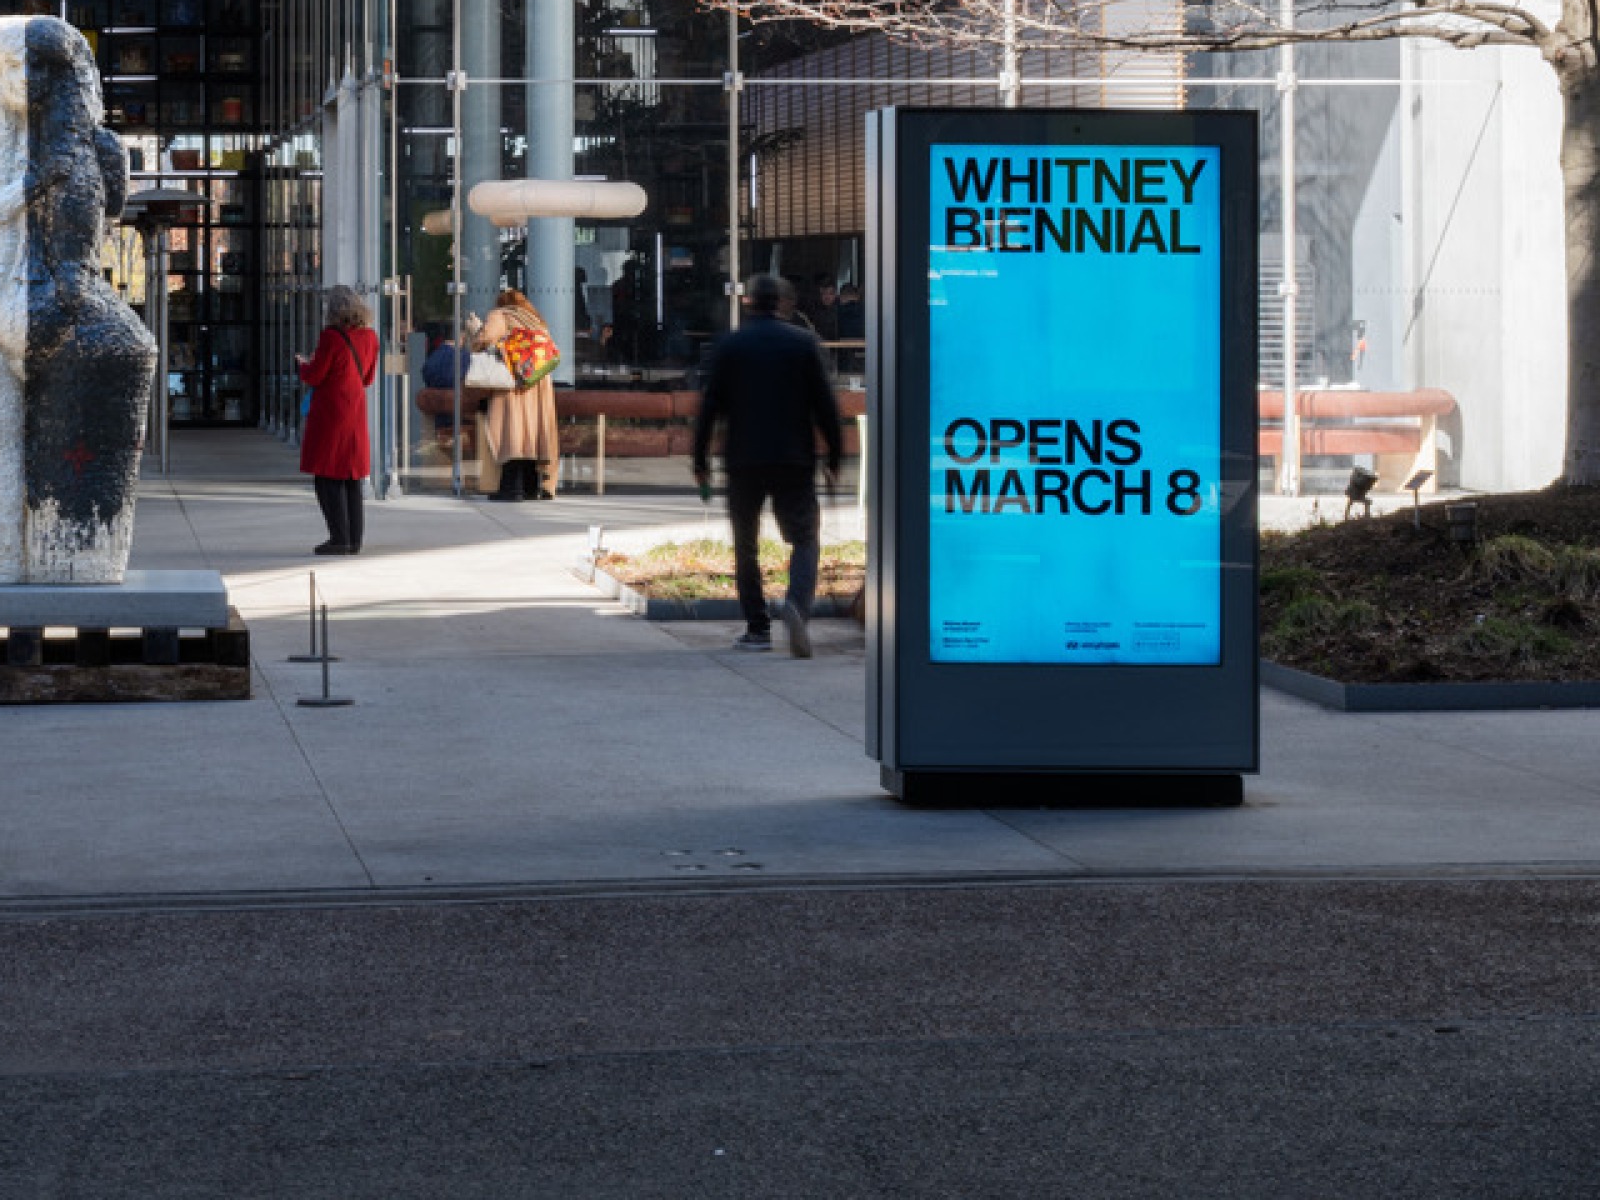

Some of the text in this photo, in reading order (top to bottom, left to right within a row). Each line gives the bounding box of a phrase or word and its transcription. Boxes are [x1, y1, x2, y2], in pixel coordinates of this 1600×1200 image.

[943, 156, 1208, 204] WHITNEY
[945, 207, 1202, 254] BIENNIAL
[943, 417, 1142, 466] OPENS
[944, 468, 1201, 516] MARCH 8
